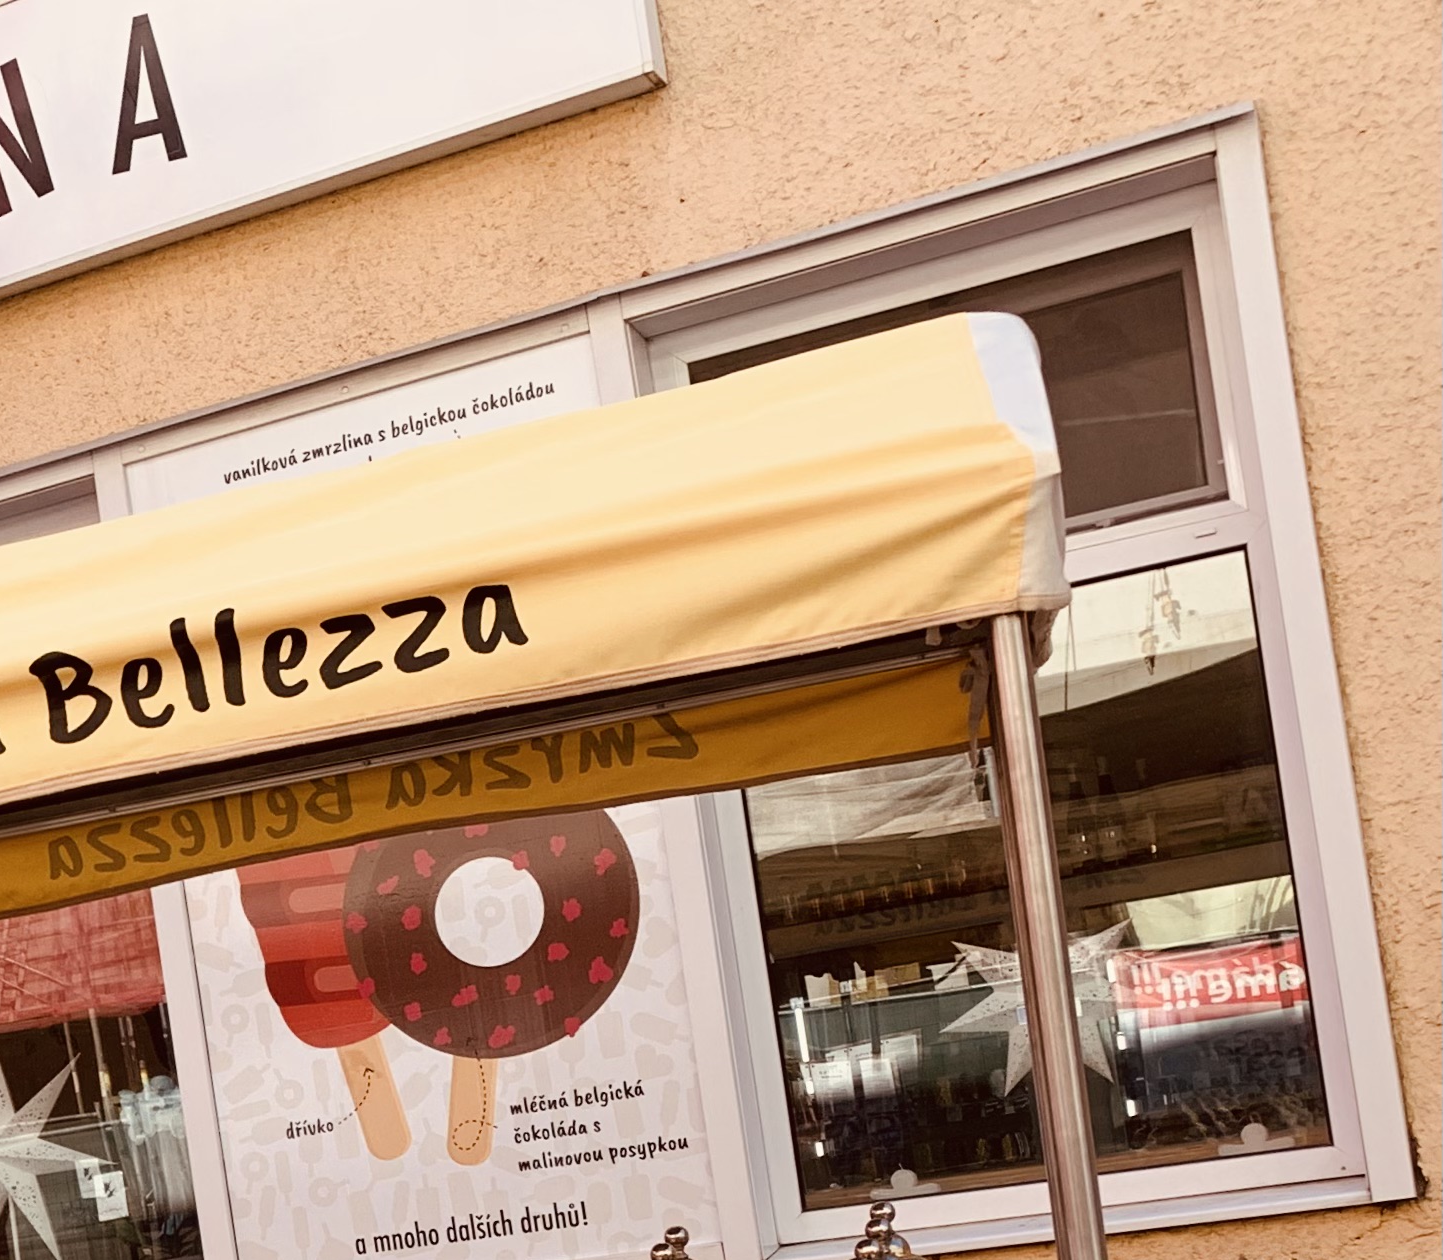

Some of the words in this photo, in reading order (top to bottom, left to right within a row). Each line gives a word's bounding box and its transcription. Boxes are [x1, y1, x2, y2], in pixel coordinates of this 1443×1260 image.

[223, 449, 299, 485] vanilková
[301, 430, 374, 464] zmrzlina
[378, 427, 387, 442] s
[391, 404, 468, 438] belgickou
[471, 380, 555, 415] čokoládou
[29, 583, 530, 746] Bellezza
[509, 1089, 570, 1116] mléčná
[574, 1079, 645, 1109] belgická
[285, 1118, 335, 1140] dřívko
[513, 1121, 589, 1145] čokoláda
[593, 1119, 603, 1134] s
[518, 1146, 604, 1172] malinovou
[608, 1135, 689, 1164] posypkou
[355, 1236, 368, 1255] a
[373, 1220, 440, 1252] mnoho
[446, 1208, 514, 1243] dalších
[520, 1200, 589, 1234] druhů!
